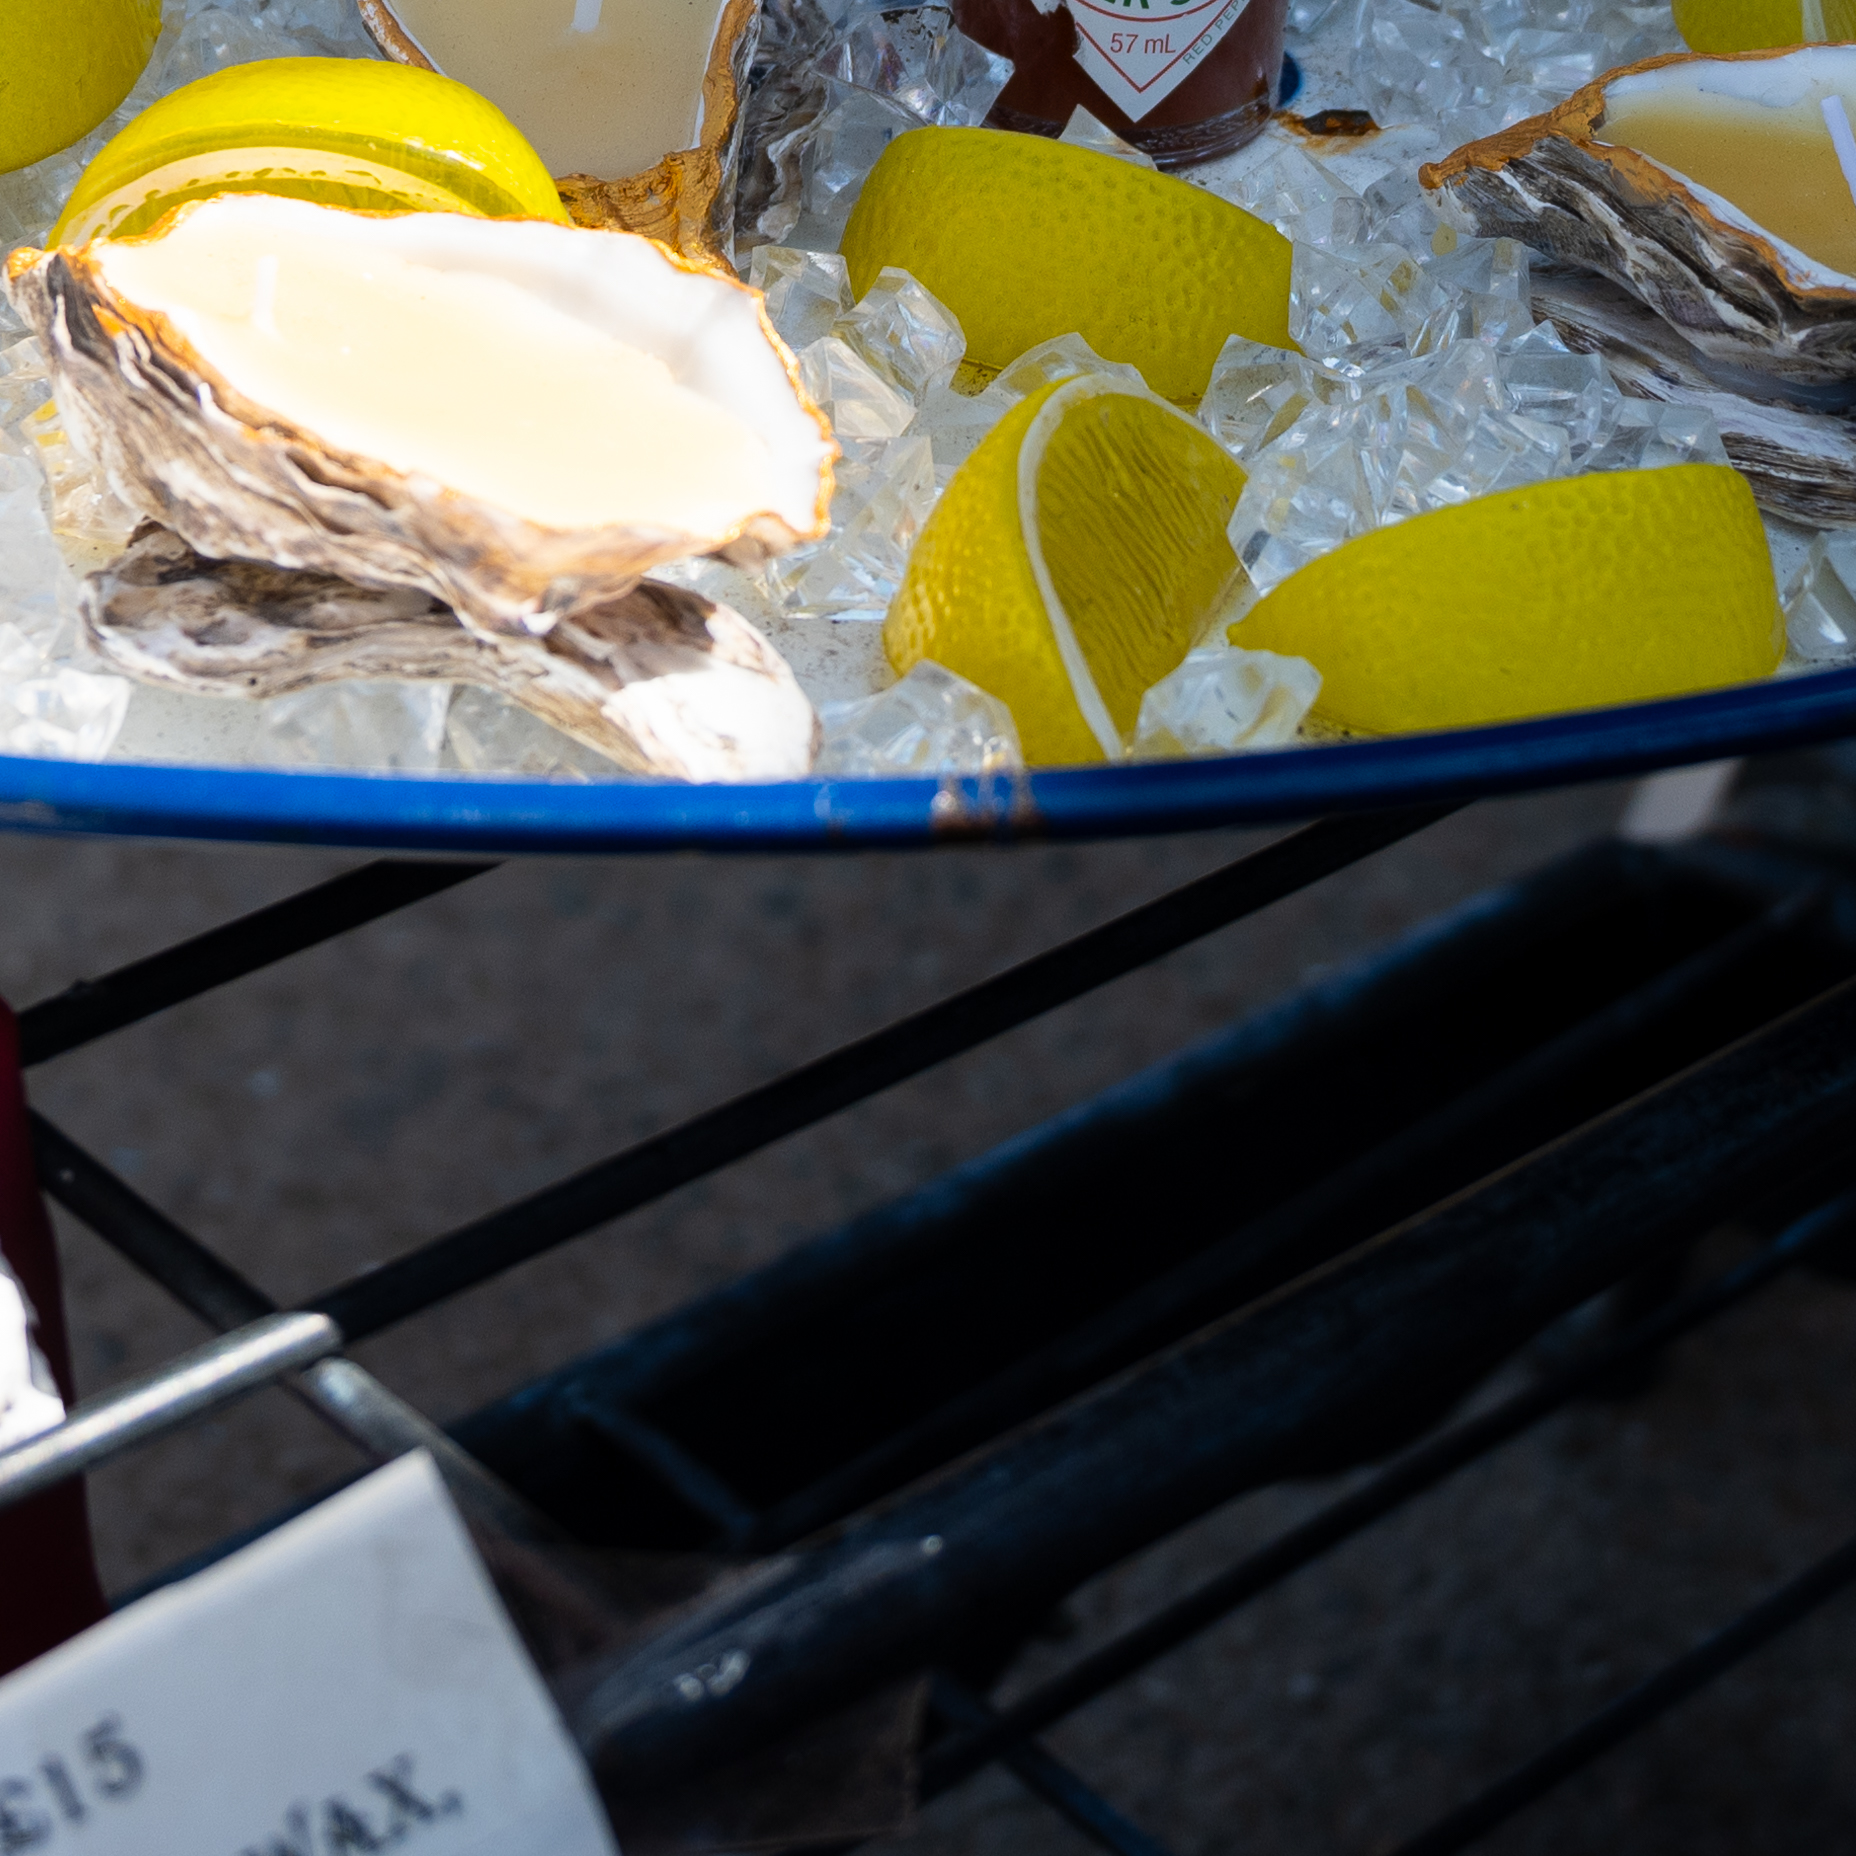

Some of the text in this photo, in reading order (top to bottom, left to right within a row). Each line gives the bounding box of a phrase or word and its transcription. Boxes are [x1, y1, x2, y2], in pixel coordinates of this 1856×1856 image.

[1109, 32, 1177, 55] 57 mL
[1182, 33, 1214, 65] RED
